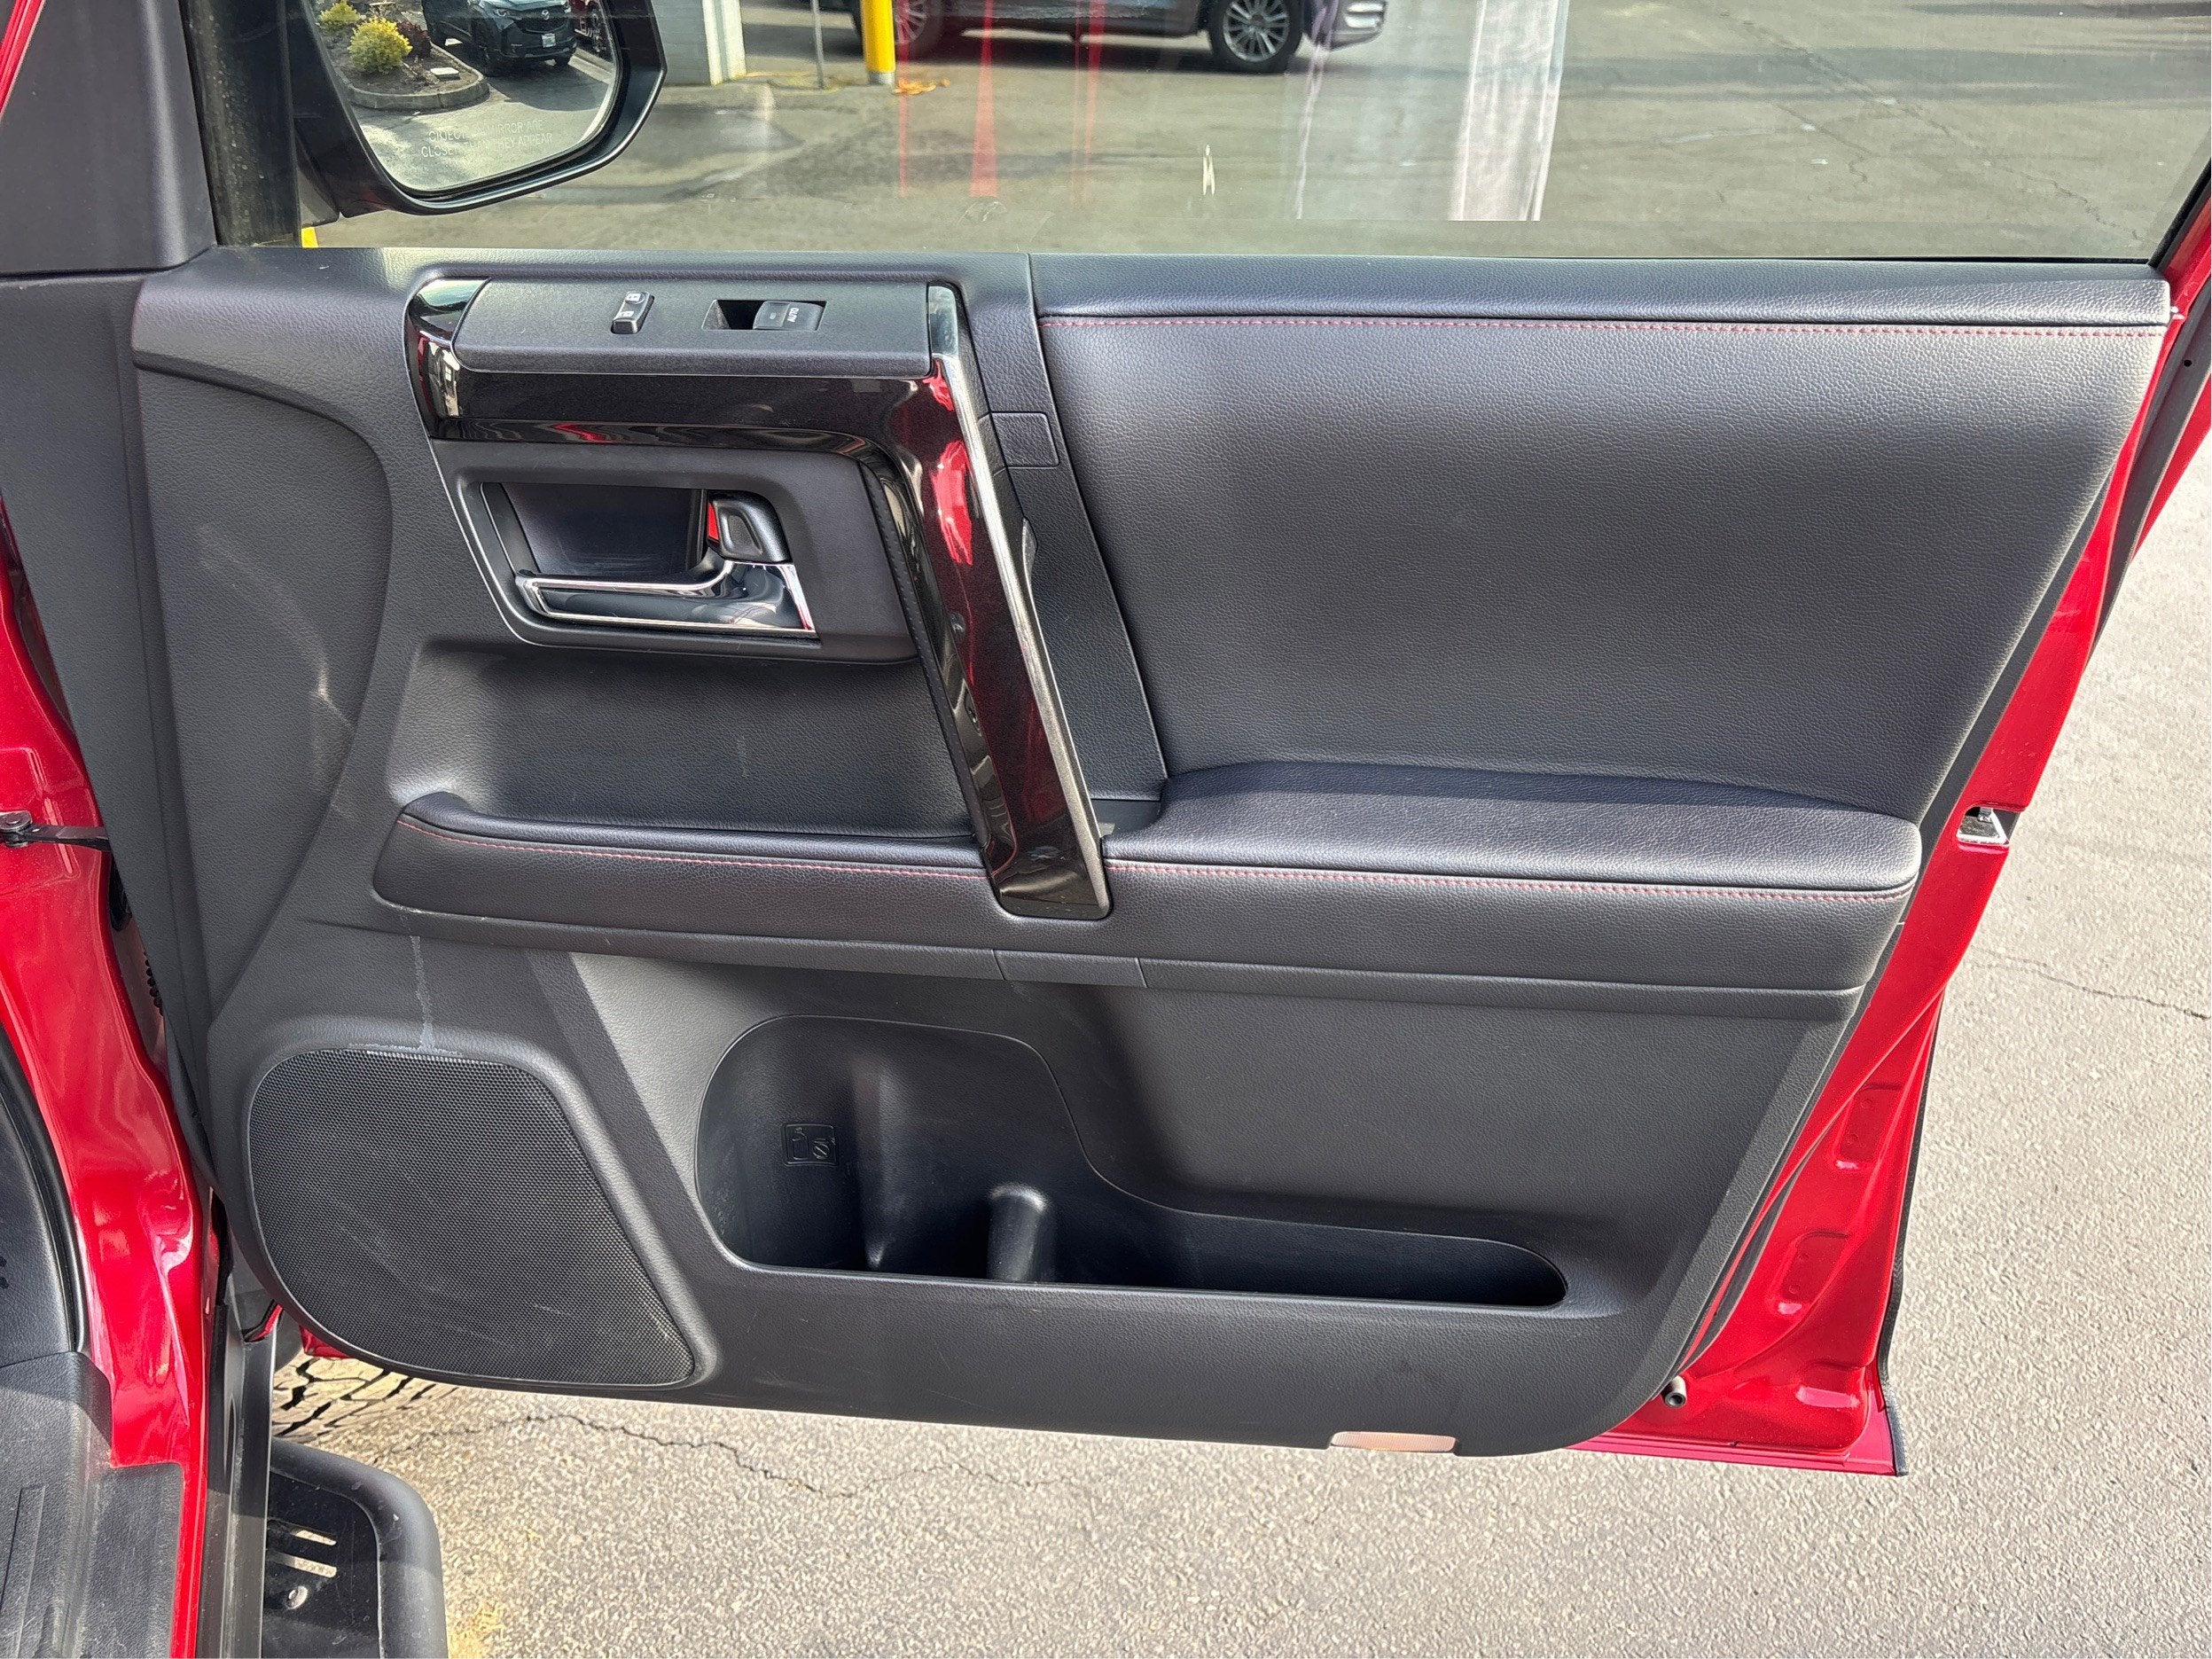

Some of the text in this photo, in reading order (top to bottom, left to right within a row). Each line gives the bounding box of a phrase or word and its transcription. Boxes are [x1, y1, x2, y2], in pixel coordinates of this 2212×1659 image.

[428, 127, 471, 142] OBJECT
[493, 136, 515, 149] HEY
[786, 307, 800, 323] AUTO
